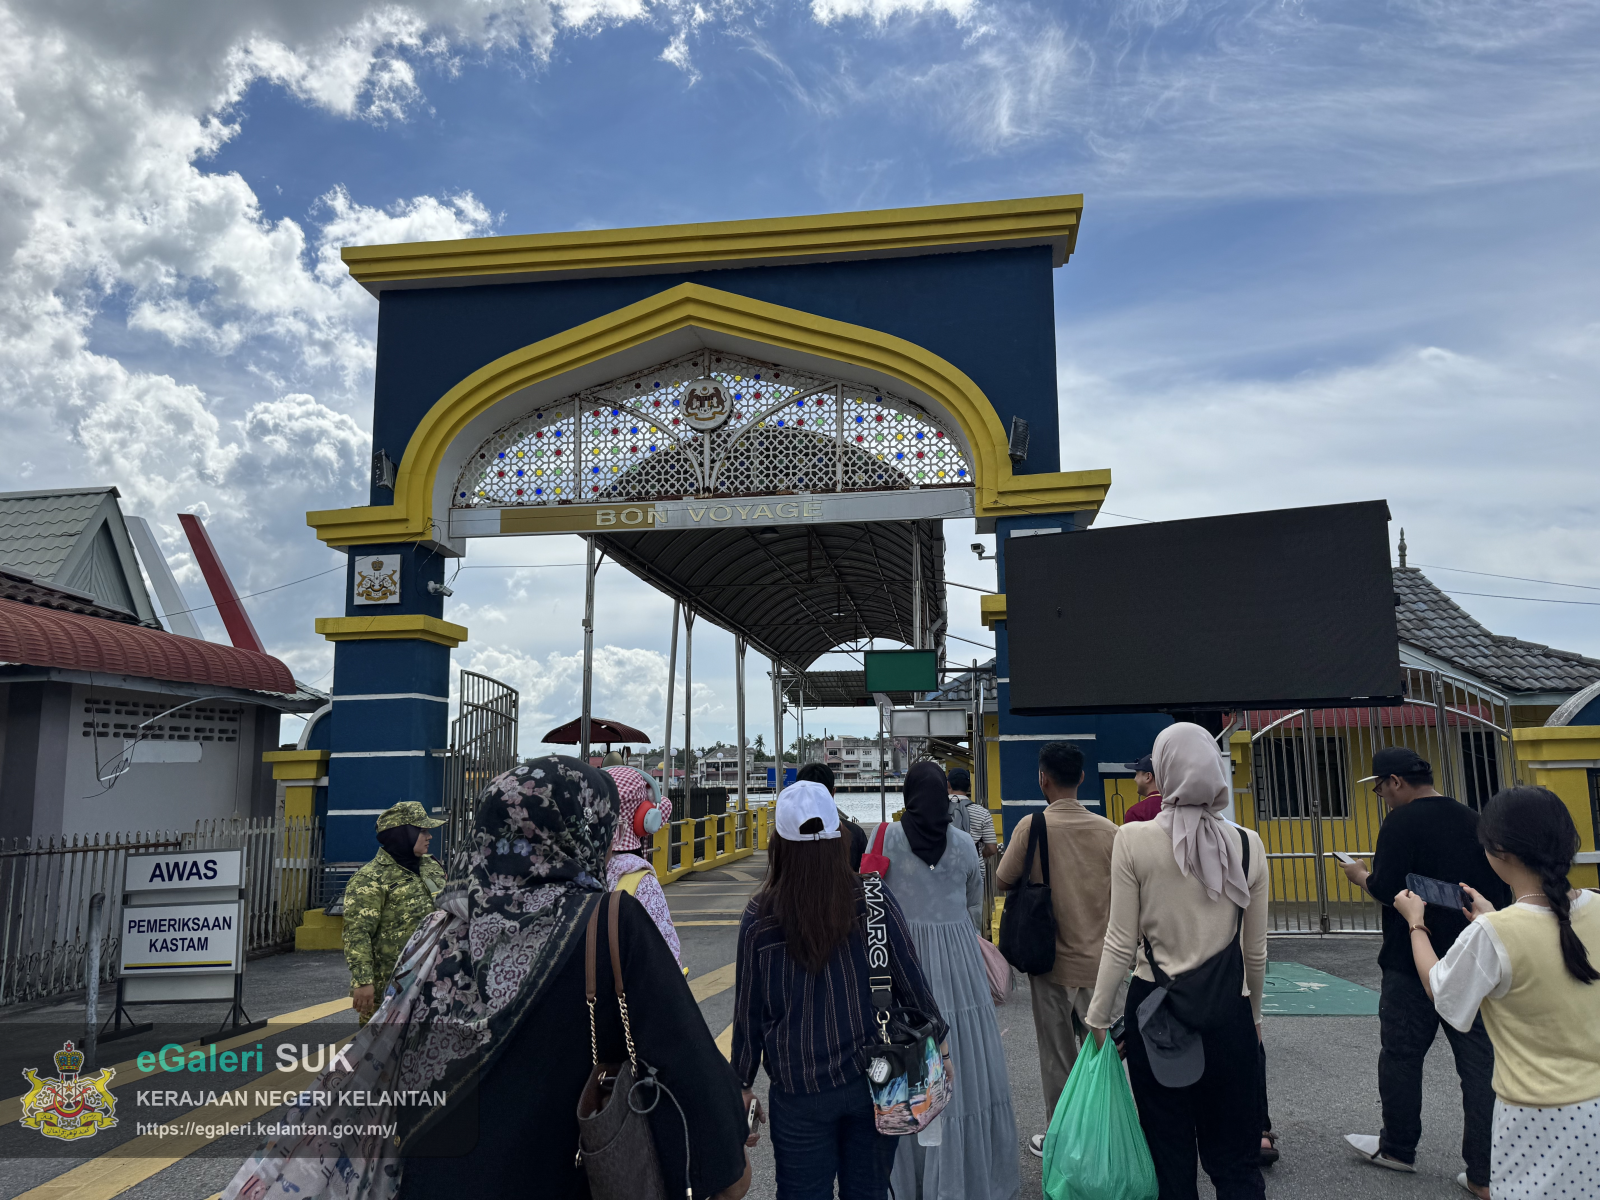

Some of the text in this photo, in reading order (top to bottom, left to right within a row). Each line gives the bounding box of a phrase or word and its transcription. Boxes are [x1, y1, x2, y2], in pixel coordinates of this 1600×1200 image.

[595, 500, 824, 526] BON VOYAGE
[148, 859, 218, 883] AWAS
[127, 915, 232, 934] PEMERIKSAAN
[863, 881, 889, 969] MARC
[148, 936, 209, 953] KASTAM
